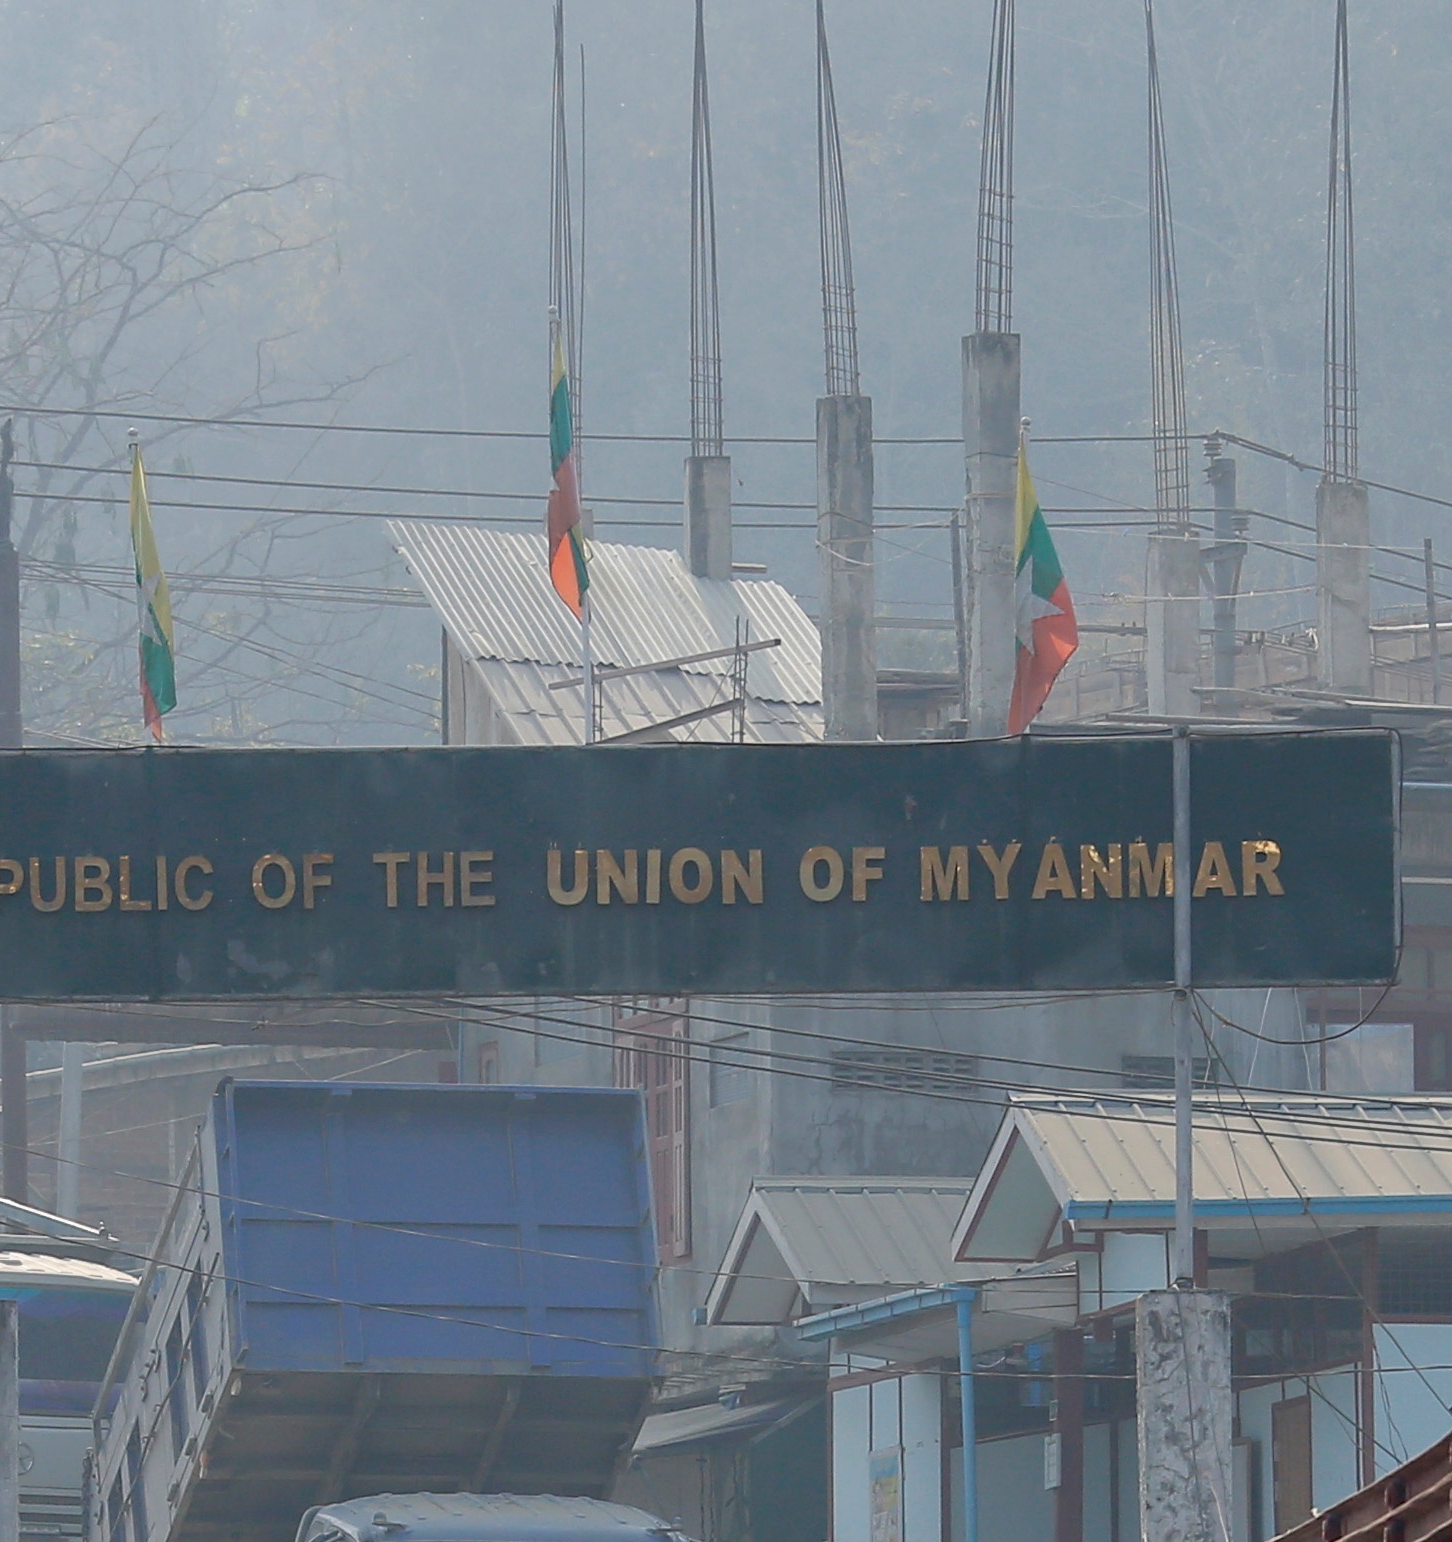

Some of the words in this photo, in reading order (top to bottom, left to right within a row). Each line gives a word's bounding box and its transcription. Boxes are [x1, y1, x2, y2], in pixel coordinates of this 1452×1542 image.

[252, 851, 333, 909] OF
[373, 850, 496, 908] THE
[547, 848, 764, 906] UNION
[800, 845, 886, 902] OF
[919, 840, 1286, 902] MYANMAR
